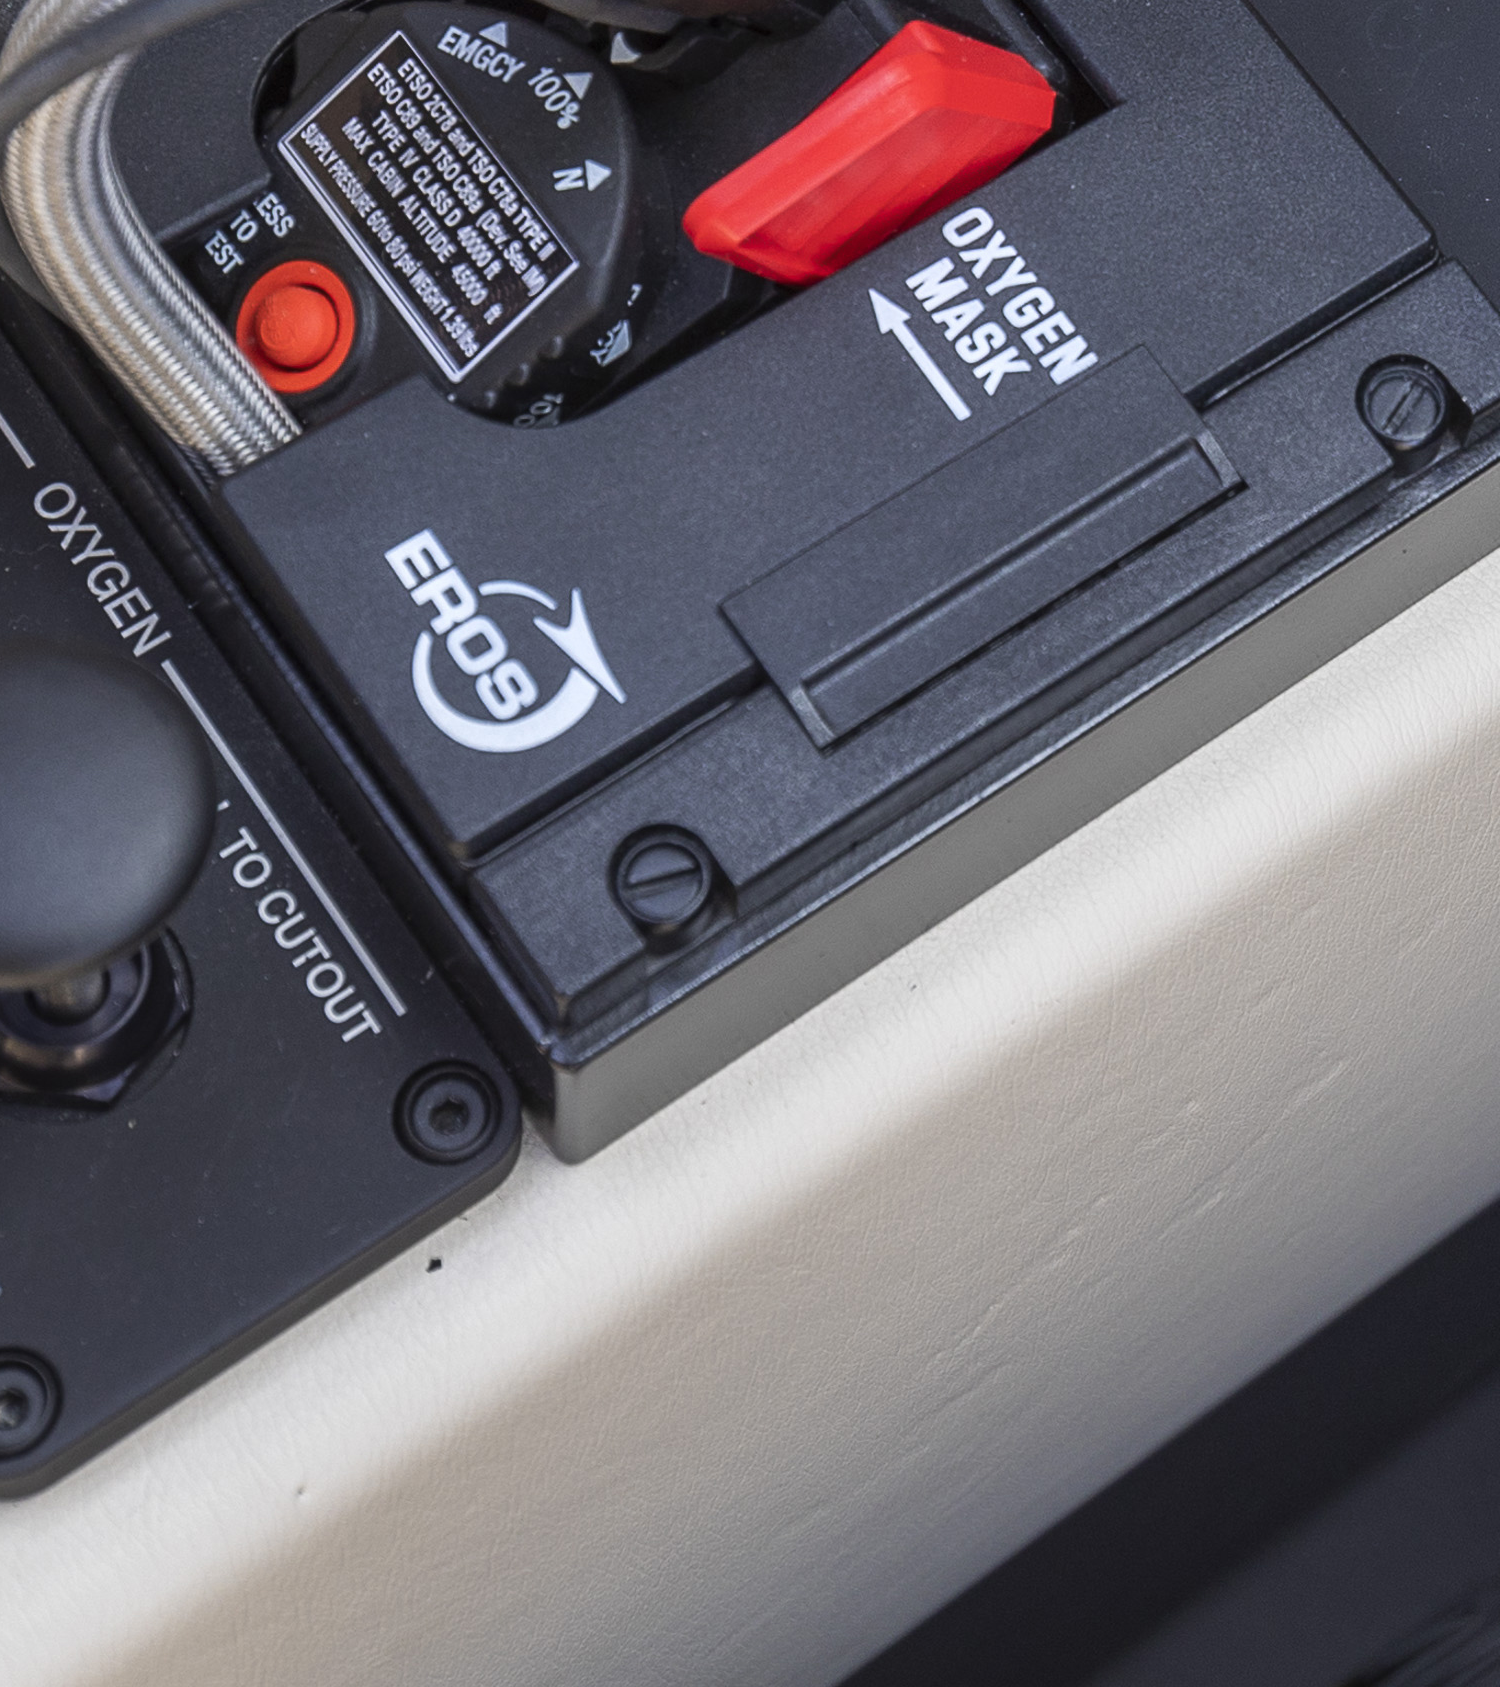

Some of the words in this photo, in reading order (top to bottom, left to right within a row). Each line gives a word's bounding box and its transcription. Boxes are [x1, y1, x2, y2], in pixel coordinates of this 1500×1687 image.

[367, 63, 403, 104] ETSO
[396, 99, 422, 129] C89
[413, 126, 441, 154] and
[432, 146, 461, 181] TSO
[398, 58, 433, 100] ETSO
[448, 128, 476, 156] and
[468, 148, 497, 183] TSO
[513, 207, 549, 251] TYPE
[437, 25, 526, 83] EMGCY
[527, 67, 581, 130] 100%
[230, 210, 258, 241] TO
[253, 193, 294, 237] ESS
[301, 123, 338, 166] SUPPLY
[328, 159, 376, 217] PRESSURE
[410, 269, 450, 314] WEIGHT
[342, 117, 374, 154] MAX
[368, 151, 406, 197] CABIN
[398, 195, 456, 263] ALTITUDE
[452, 263, 488, 305] 45000
[484, 303, 502, 324] ft
[372, 110, 406, 152] TYPE
[399, 148, 420, 168] IV
[413, 166, 454, 215] CLASS
[444, 208, 463, 226] D
[457, 226, 494, 267] 40000
[552, 166, 586, 191] N
[906, 257, 1031, 395] MASK
[943, 207, 1098, 385] OXYGEN
[33, 481, 173, 658] OXYGEN
[384, 528, 539, 720] EROS
[218, 826, 273, 888] TO
[257, 889, 383, 1043] CUTOUT
